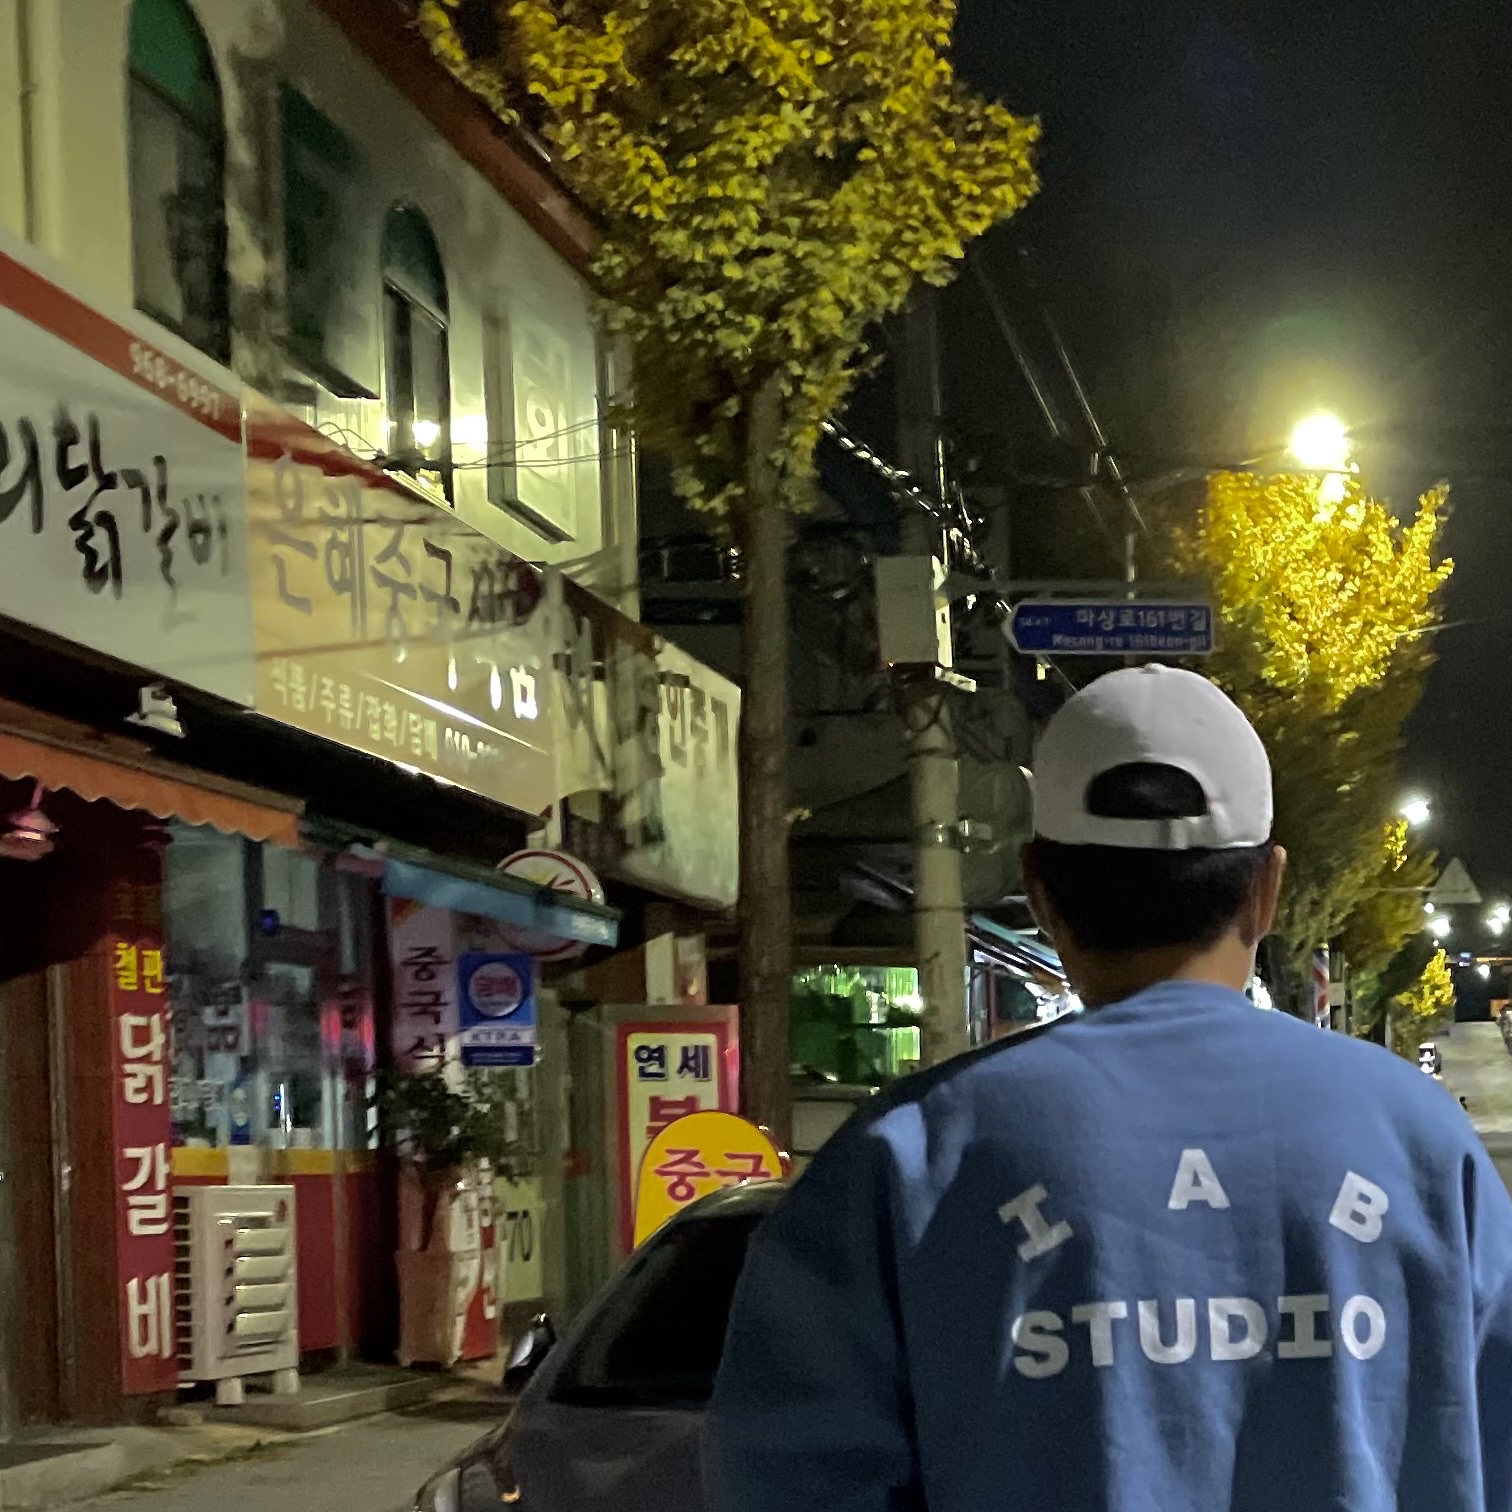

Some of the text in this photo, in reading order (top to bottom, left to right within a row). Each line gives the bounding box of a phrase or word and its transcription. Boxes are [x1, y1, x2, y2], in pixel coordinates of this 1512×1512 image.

[115, 942, 163, 994] 철판
[634, 1044, 711, 1080] 연세
[1010, 1294, 1388, 1380] STUDIO
